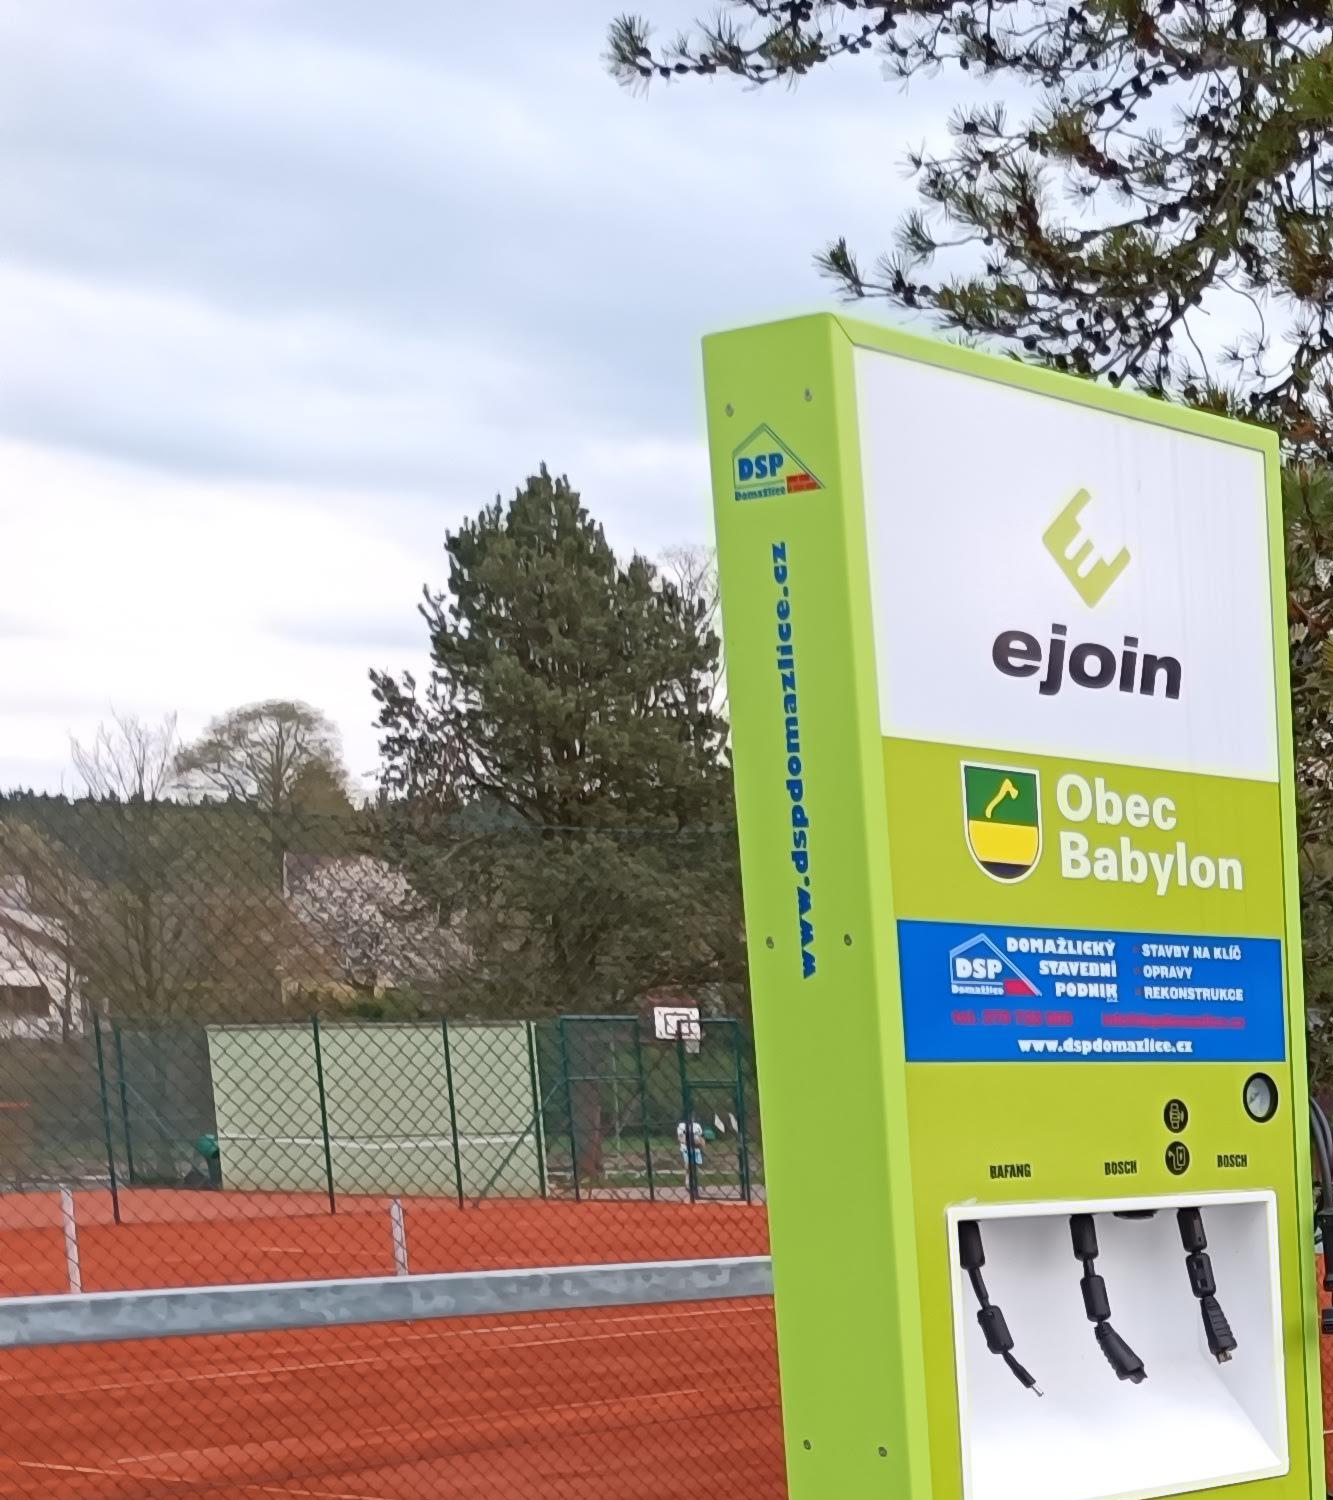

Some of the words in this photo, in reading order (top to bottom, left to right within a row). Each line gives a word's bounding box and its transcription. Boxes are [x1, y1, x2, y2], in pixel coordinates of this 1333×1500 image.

[738, 452, 783, 481] DSP
[991, 622, 1182, 700] ejoin
[772, 541, 816, 980] www.dspdomazlice.cz
[1056, 772, 1177, 832] Obec
[1059, 831, 1244, 896] Babylon
[1006, 936, 1116, 957] DOMAŽLICKÝ
[1141, 943, 1190, 959] STAVBY
[1192, 945, 1211, 960] NA
[955, 957, 1003, 980] DSP
[1039, 960, 1118, 978] STAVEBNÍ
[1143, 964, 1193, 980] OPRAVY
[1055, 981, 1118, 999] PODNIK
[1143, 985, 1244, 1002] REKONSTRUKCE
[1017, 1037, 1193, 1056] www.dspdomazlice.cz
[1104, 1159, 1138, 1176] BOSCH
[1217, 1153, 1248, 1168] BOSCH
[989, 1163, 1032, 1179] BAFANG
